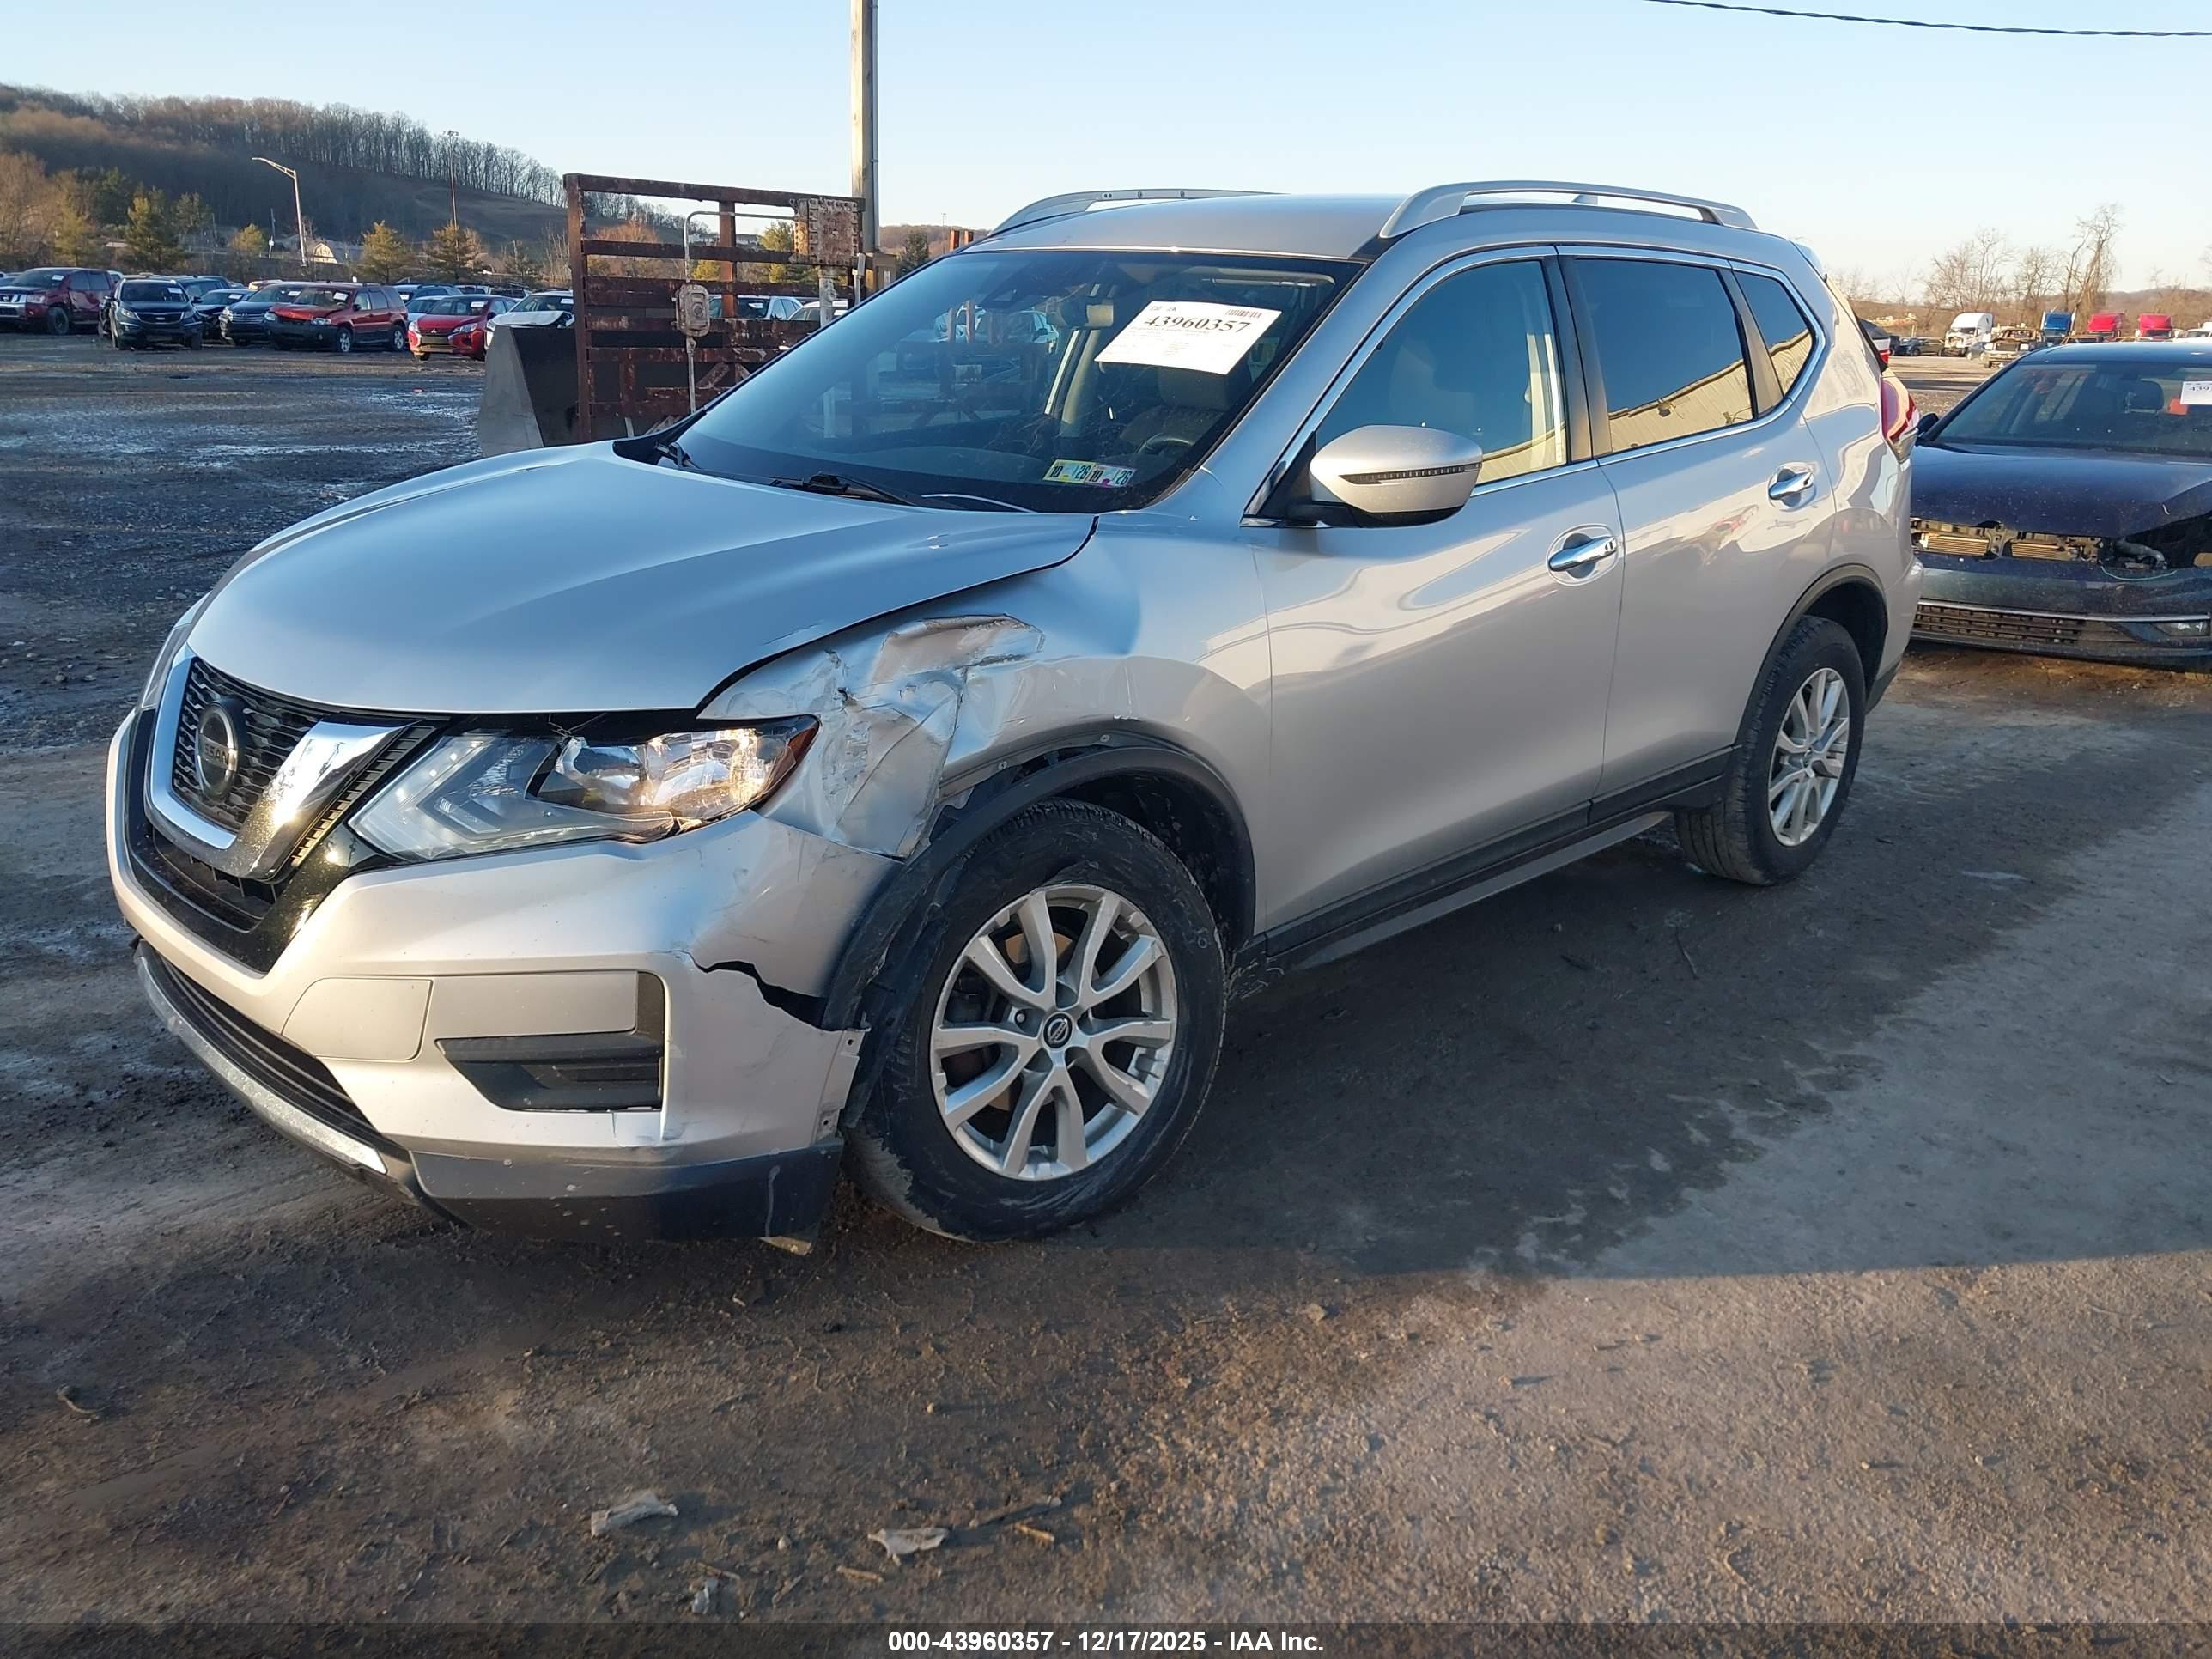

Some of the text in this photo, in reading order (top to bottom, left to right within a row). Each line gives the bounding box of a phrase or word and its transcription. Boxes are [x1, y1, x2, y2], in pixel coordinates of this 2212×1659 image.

[1145, 315, 1252, 333] 43960357
[1049, 465, 1091, 480] 10 26
[1089, 470, 1133, 485] 10 26
